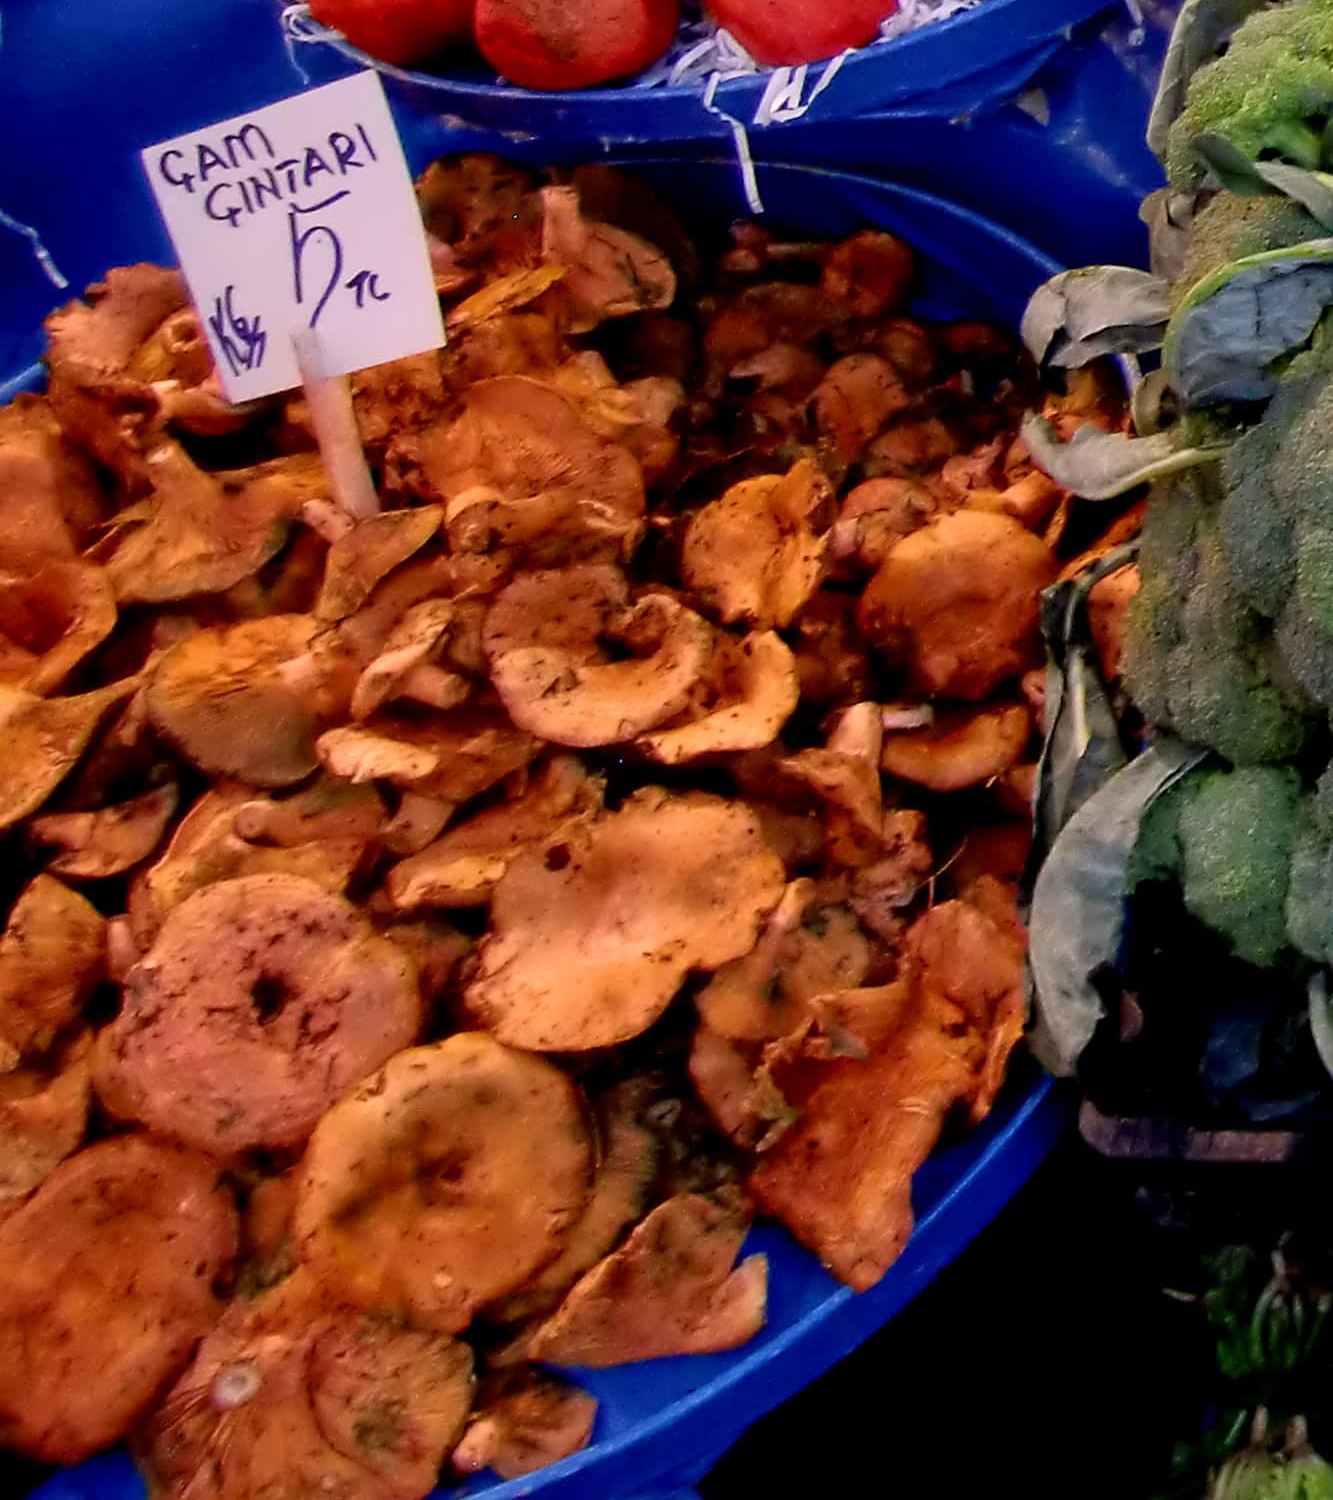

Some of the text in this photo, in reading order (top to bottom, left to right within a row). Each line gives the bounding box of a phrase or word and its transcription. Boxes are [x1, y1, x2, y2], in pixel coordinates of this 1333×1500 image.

[159, 123, 275, 193] ÇAM
[204, 123, 378, 227] ÇINTARI
[288, 190, 351, 329] 5
